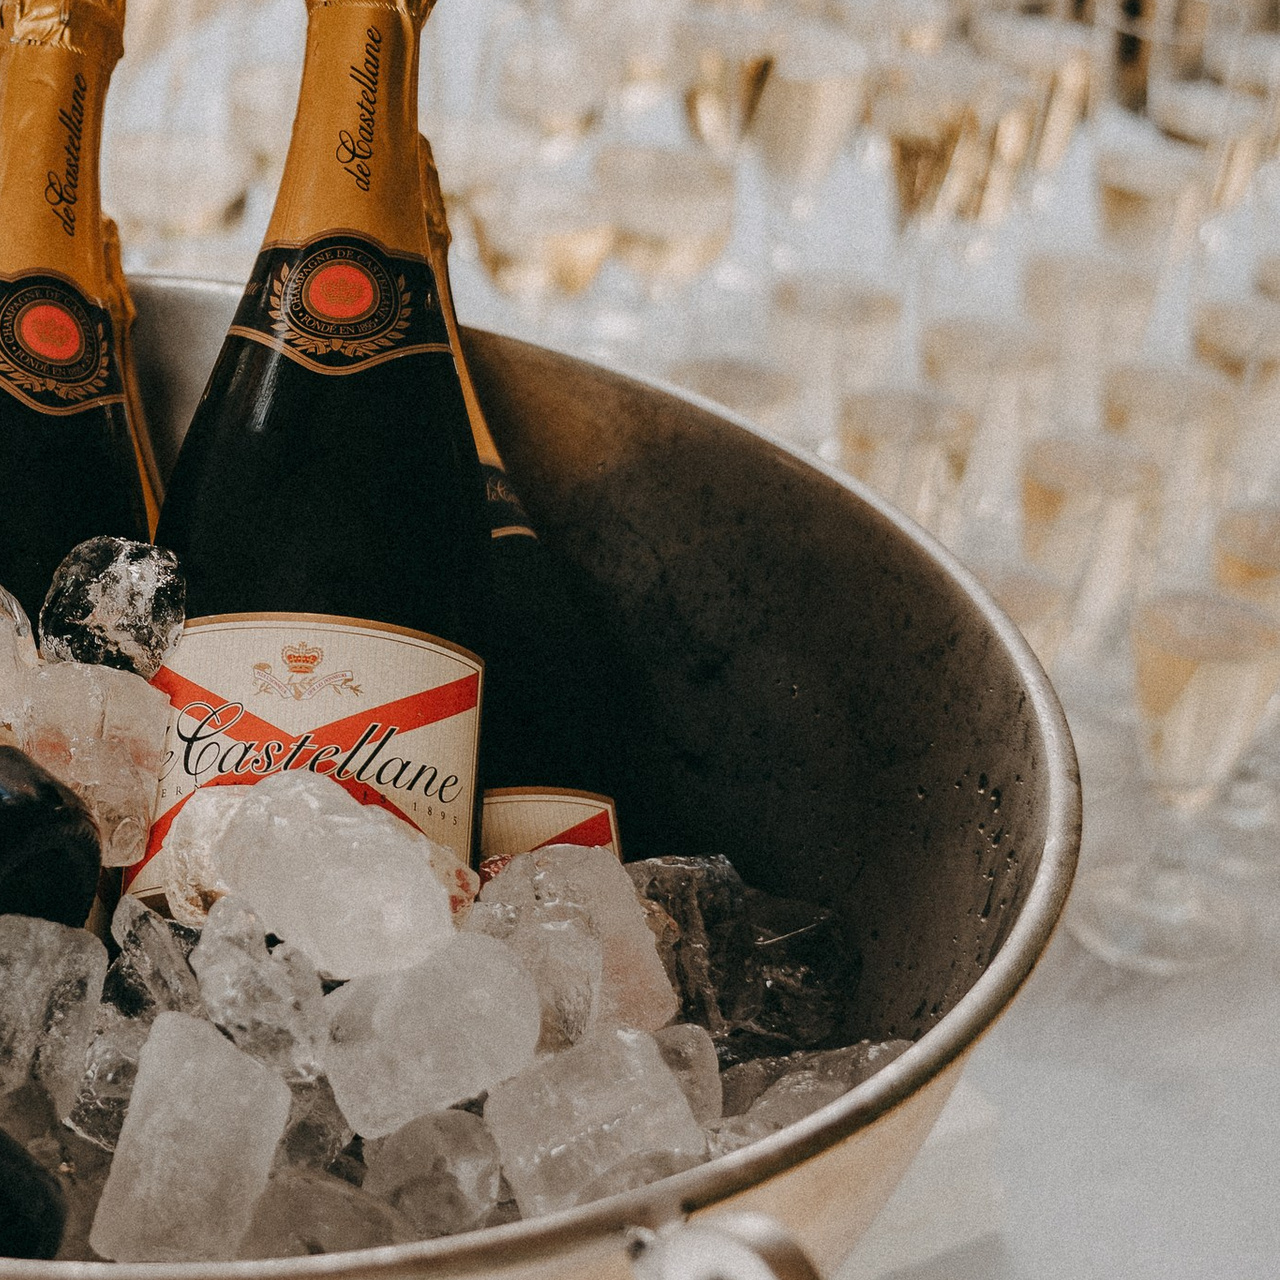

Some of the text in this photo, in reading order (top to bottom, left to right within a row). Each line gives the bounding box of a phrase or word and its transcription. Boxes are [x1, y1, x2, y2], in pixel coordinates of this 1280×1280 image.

[291, 249, 391, 321] CHAMPAGNE DE CASTELLANE
[3, 290, 43, 344] CHAMPAGNE
[45, 290, 60, 300] DE
[300, 314, 337, 334] FONDÉ
[339, 324, 356, 335] EN
[176, 701, 464, 803] Castellane
[413, 802, 458, 826] 1895
